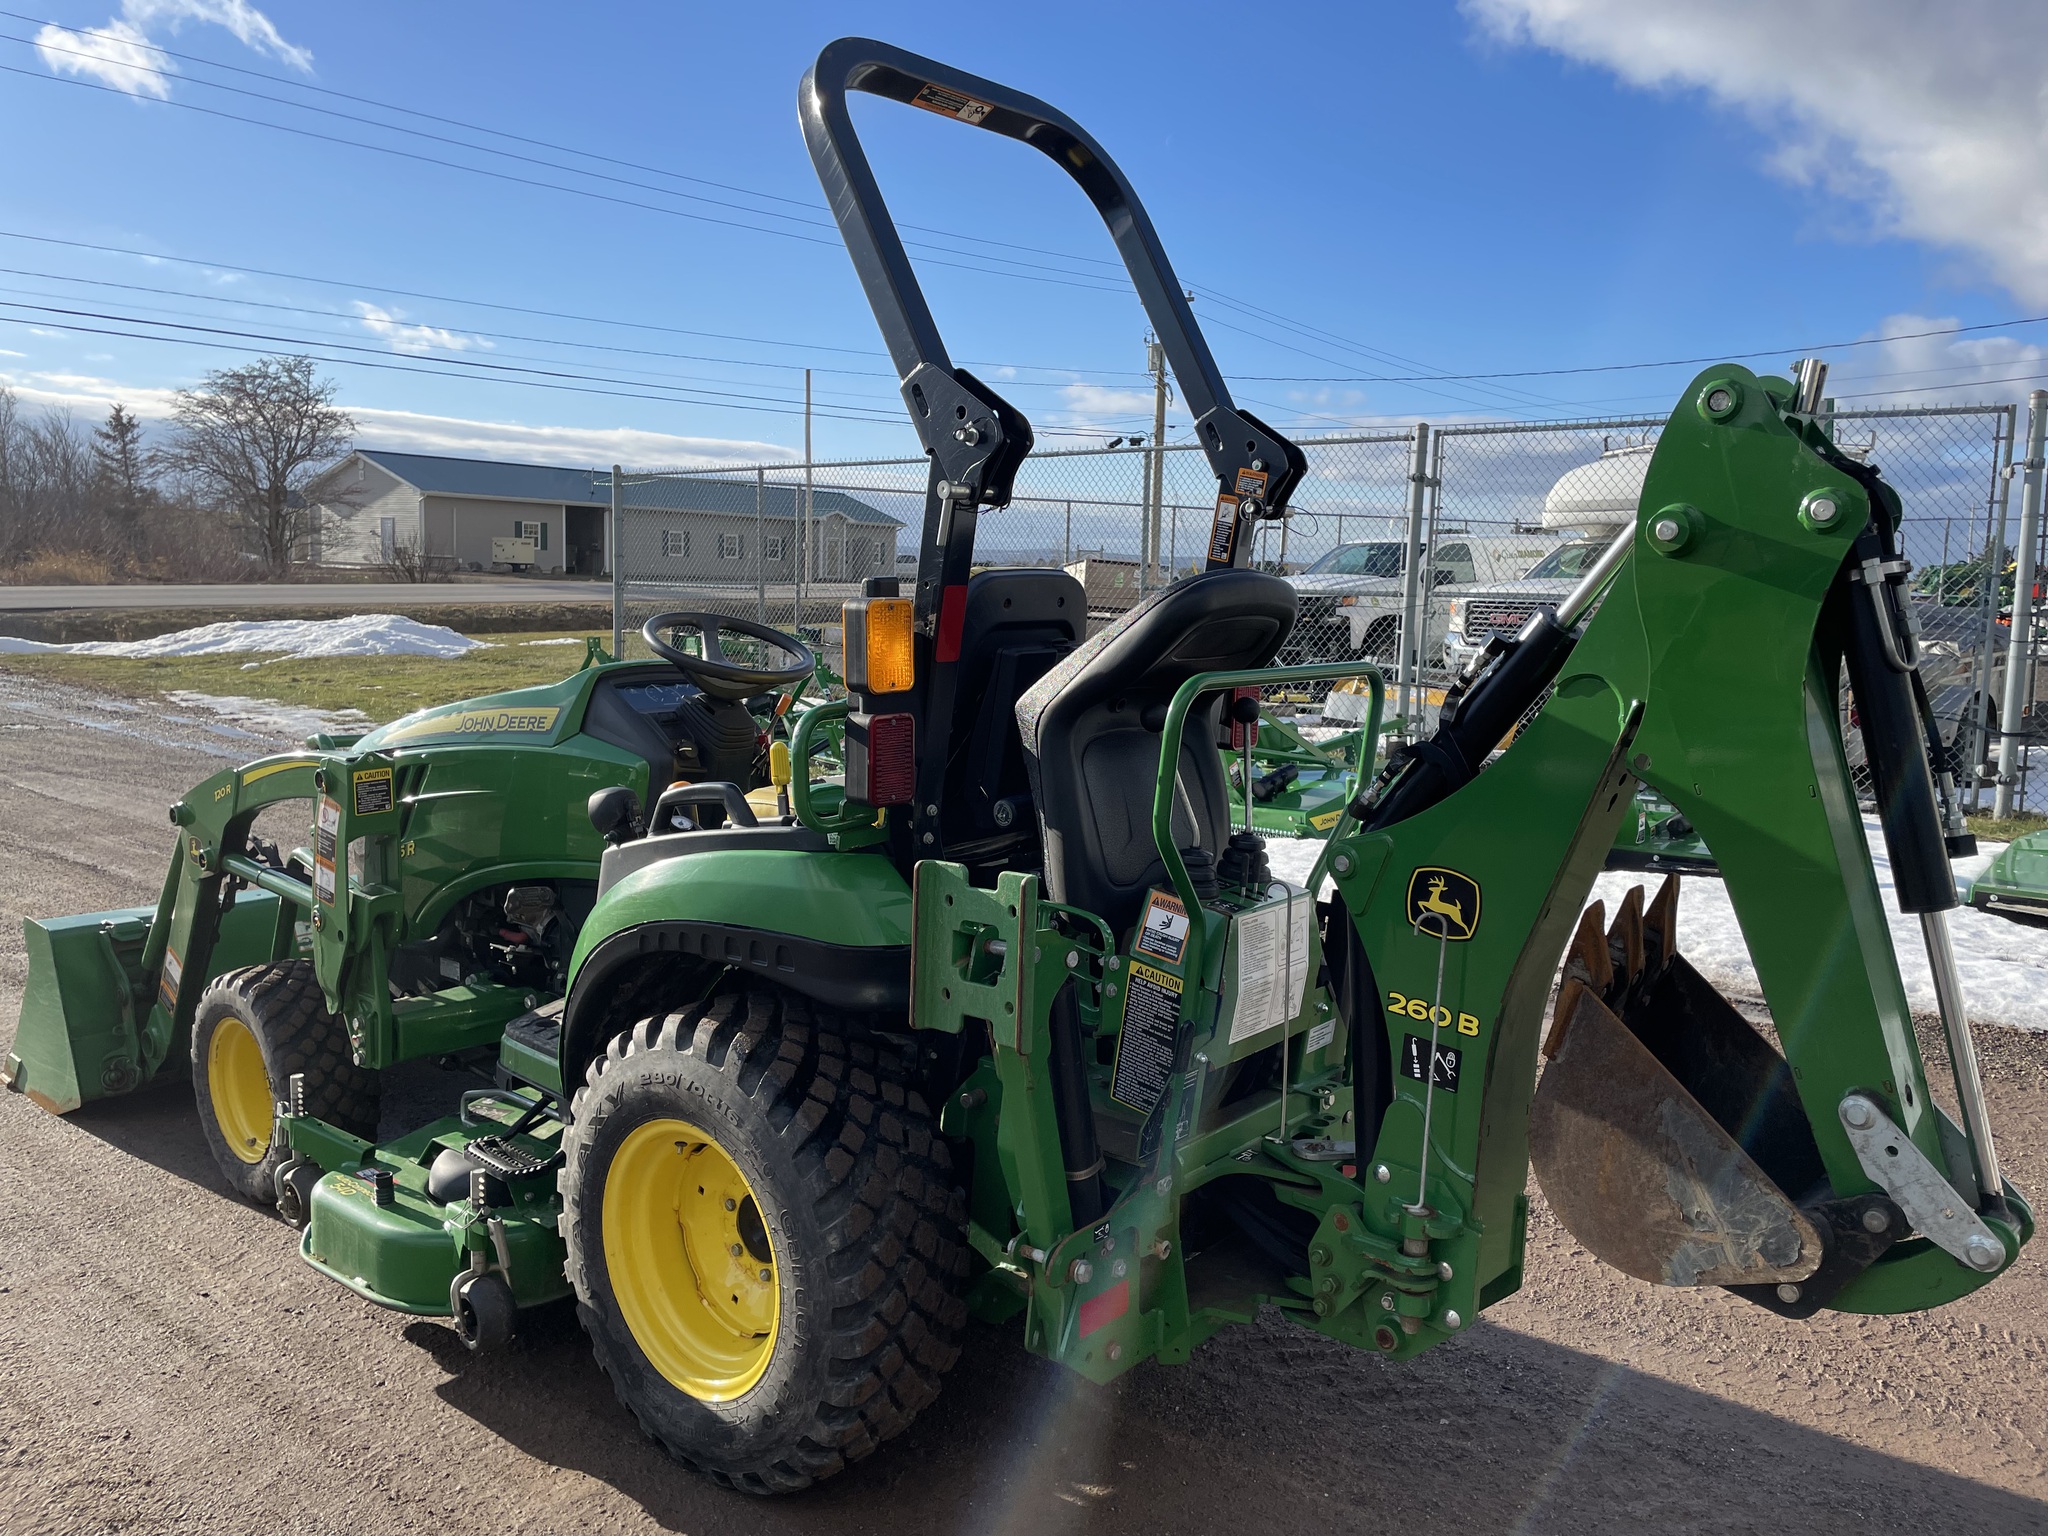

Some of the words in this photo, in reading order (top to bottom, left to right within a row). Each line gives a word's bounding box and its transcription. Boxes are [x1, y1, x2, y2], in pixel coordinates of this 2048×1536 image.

[1489, 613, 1527, 624] GMC
[455, 715, 496, 732] JOHN
[496, 713, 548, 731] DEERE
[364, 770, 390, 780] CAUTION
[1160, 898, 1188, 916] WARNIN
[1144, 968, 1181, 991] CAUTION
[1387, 991, 1453, 1028] 260
[1457, 1010, 1480, 1038] B
